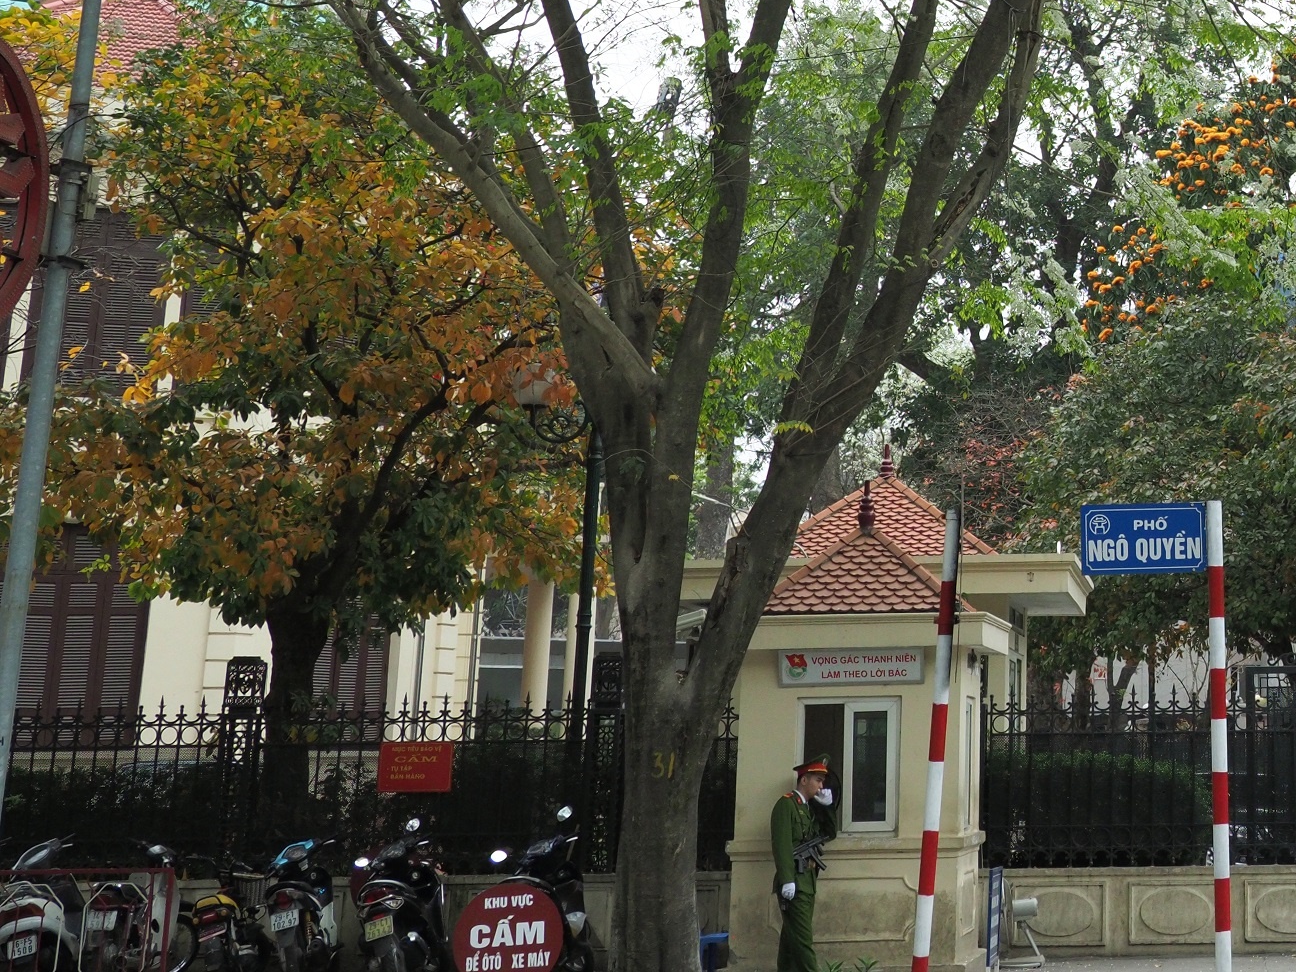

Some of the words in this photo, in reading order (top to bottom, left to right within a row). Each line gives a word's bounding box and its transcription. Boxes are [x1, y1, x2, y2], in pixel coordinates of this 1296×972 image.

[1133, 515, 1169, 531] PHỐ
[1088, 533, 1129, 563] NGÔ
[1135, 530, 1201, 563] QUYỀN
[811, 656, 838, 666] VỌNG
[840, 654, 860, 664] GÁC
[862, 655, 893, 664] THANH
[895, 653, 917, 663] NIÊN
[821, 669, 841, 679] LÀM
[843, 669, 868, 679] THEO
[870, 668, 886, 678] LỜI
[888, 667, 908, 677] BÁC
[394, 753, 438, 763] CẤM
[484, 896, 508, 910] KHU
[511, 893, 534, 909] VỰC
[469, 914, 546, 949] CẤM
[465, 950, 480, 972] ĐỂ
[482, 951, 502, 971] ÔTÔ
[511, 952, 525, 969] XE
[528, 949, 551, 967] MÁY
